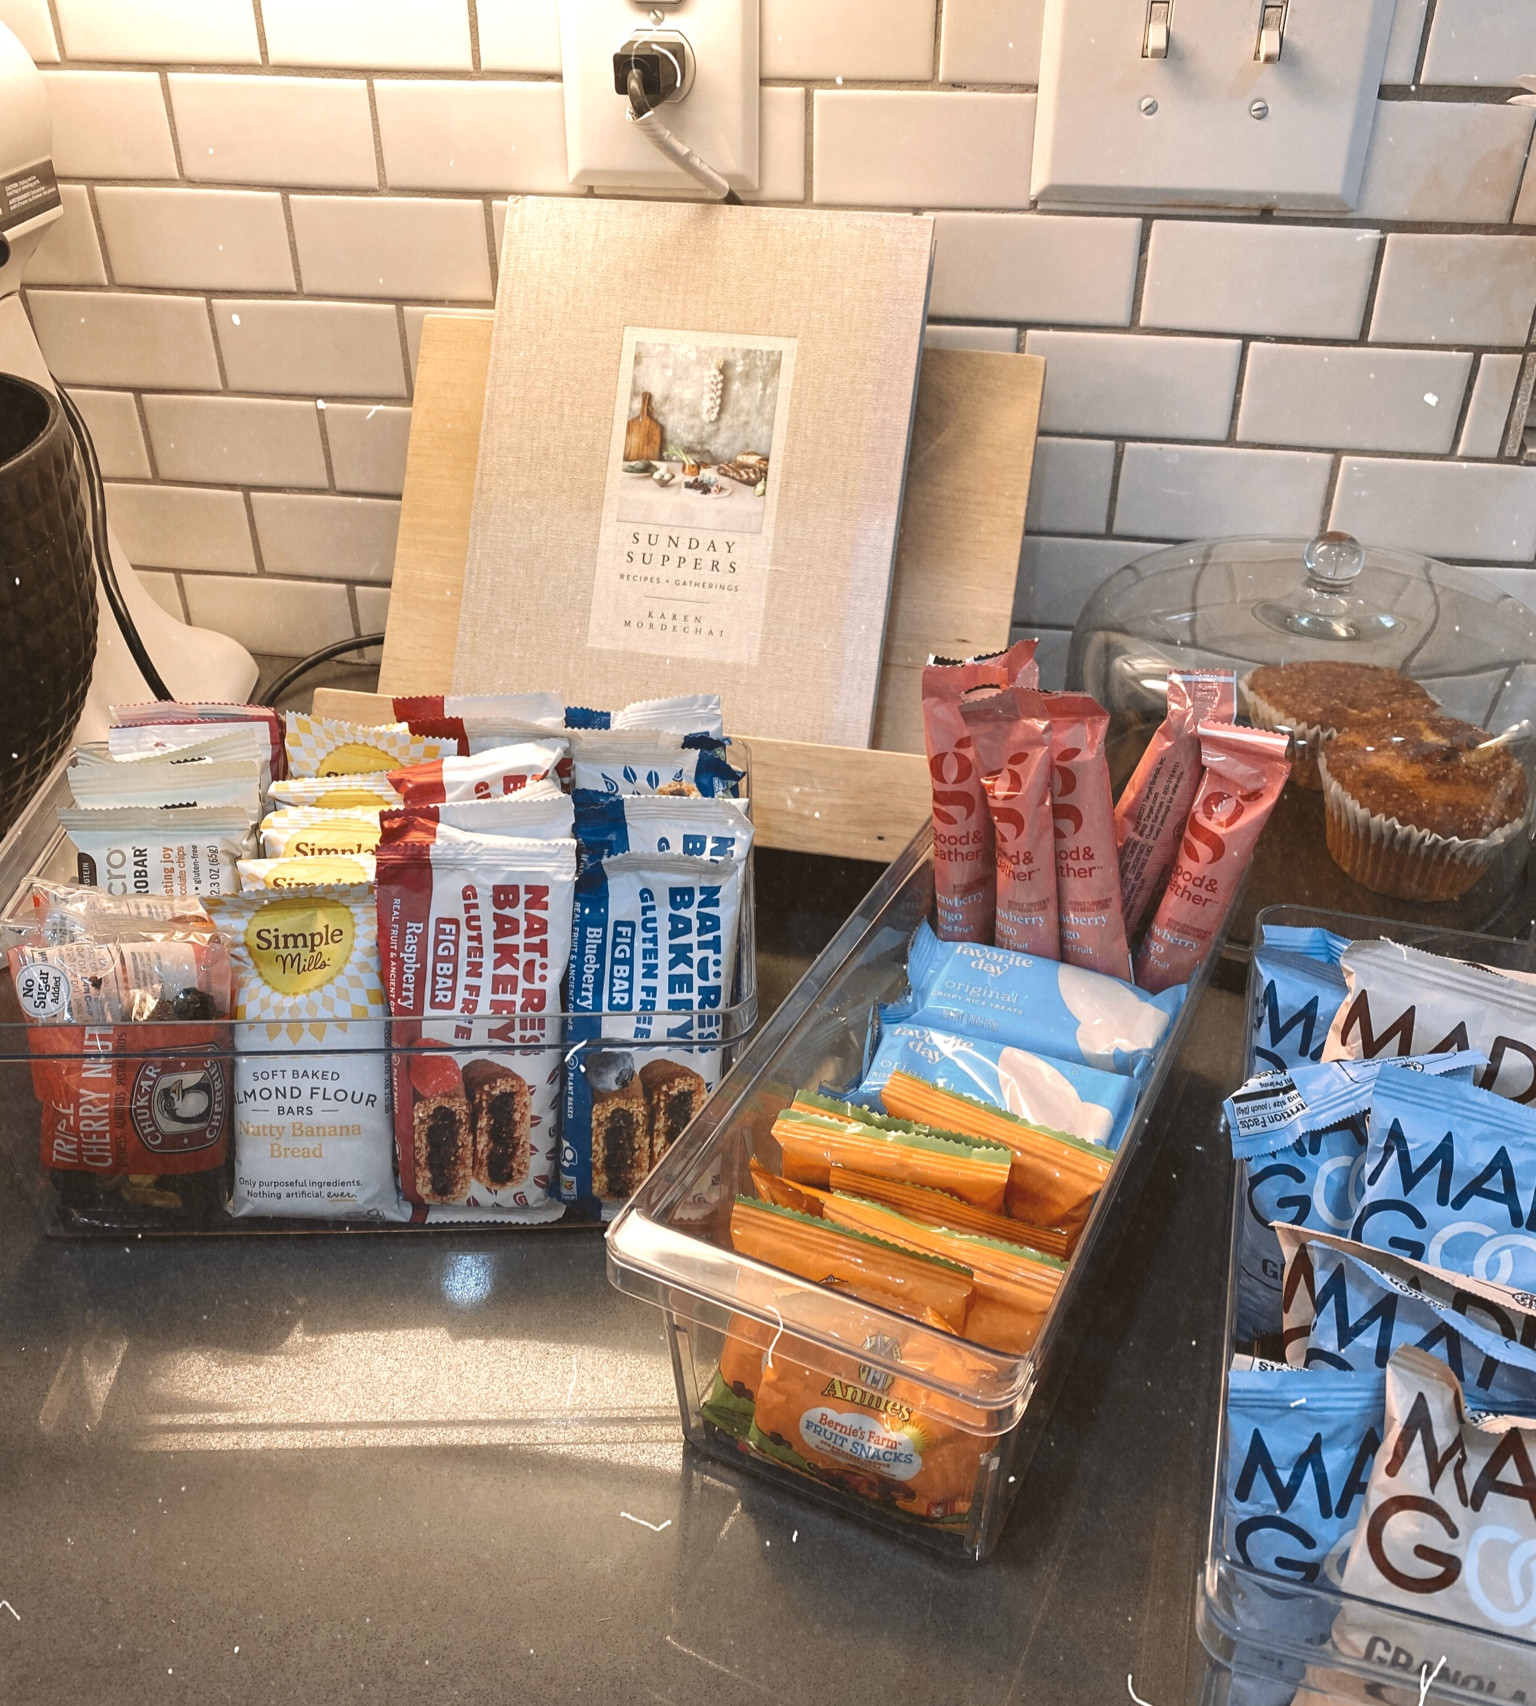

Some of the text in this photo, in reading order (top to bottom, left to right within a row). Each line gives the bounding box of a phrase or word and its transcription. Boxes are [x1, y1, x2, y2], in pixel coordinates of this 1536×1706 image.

[632, 532, 736, 553] SUNDAY
[626, 551, 737, 574] SUPPERS
[619, 573, 661, 584] RECIPES
[674, 579, 740, 592] GATHERINGS
[624, 620, 724, 638] MORDECHAI
[648, 611, 703, 624] KAREN
[176, 846, 187, 868] chips
[190, 844, 202, 884] gluten-free
[207, 845, 220, 867] (65g)
[160, 847, 174, 896] sting joy
[1174, 865, 1218, 894] ood&
[210, 880, 220, 896] 2.3
[392, 898, 400, 922] REAL
[572, 902, 580, 924] REAL
[256, 925, 344, 952] Simple
[390, 924, 399, 950] FRUIT
[462, 884, 484, 979] GLUTEN
[570, 926, 579, 952] FRUIT
[639, 888, 659, 980] GLUTEN
[276, 951, 327, 976] Mills
[398, 922, 424, 1009] Raspberry
[434, 924, 456, 1003] FIG BAR
[577, 926, 603, 1010] Blueberry
[612, 926, 632, 1005] FIG BAR
[956, 944, 1034, 968] favorite
[970, 958, 1009, 978] day
[22, 978, 34, 998] No
[34, 970, 50, 1009] Sugar
[51, 976, 62, 1004] Added
[568, 963, 576, 1000] ANCIENT
[990, 1002, 1023, 1015] TREATS
[909, 1040, 946, 1064] day
[252, 1070, 340, 1082] SOFT BAKED
[136, 1064, 162, 1145] CHUKAR
[204, 1060, 223, 1140] CHERRIES
[310, 1086, 377, 1108] FLOUR
[278, 1106, 314, 1116] BARS
[78, 1088, 112, 1168] CHERRY
[238, 1120, 362, 1140] Nutty Banana
[1240, 1117, 1267, 1130] Facts
[269, 1143, 324, 1158] Bread
[238, 1177, 363, 1188] Only purposeful ingredients.
[1367, 1117, 1536, 1231] MA
[247, 1190, 282, 1200] Nothing
[286, 1190, 325, 1200] artificial,
[805, 1420, 848, 1448] FRUIT
[850, 1441, 913, 1464] SNACKS
[818, 1412, 898, 1450] Bernie's Farm
